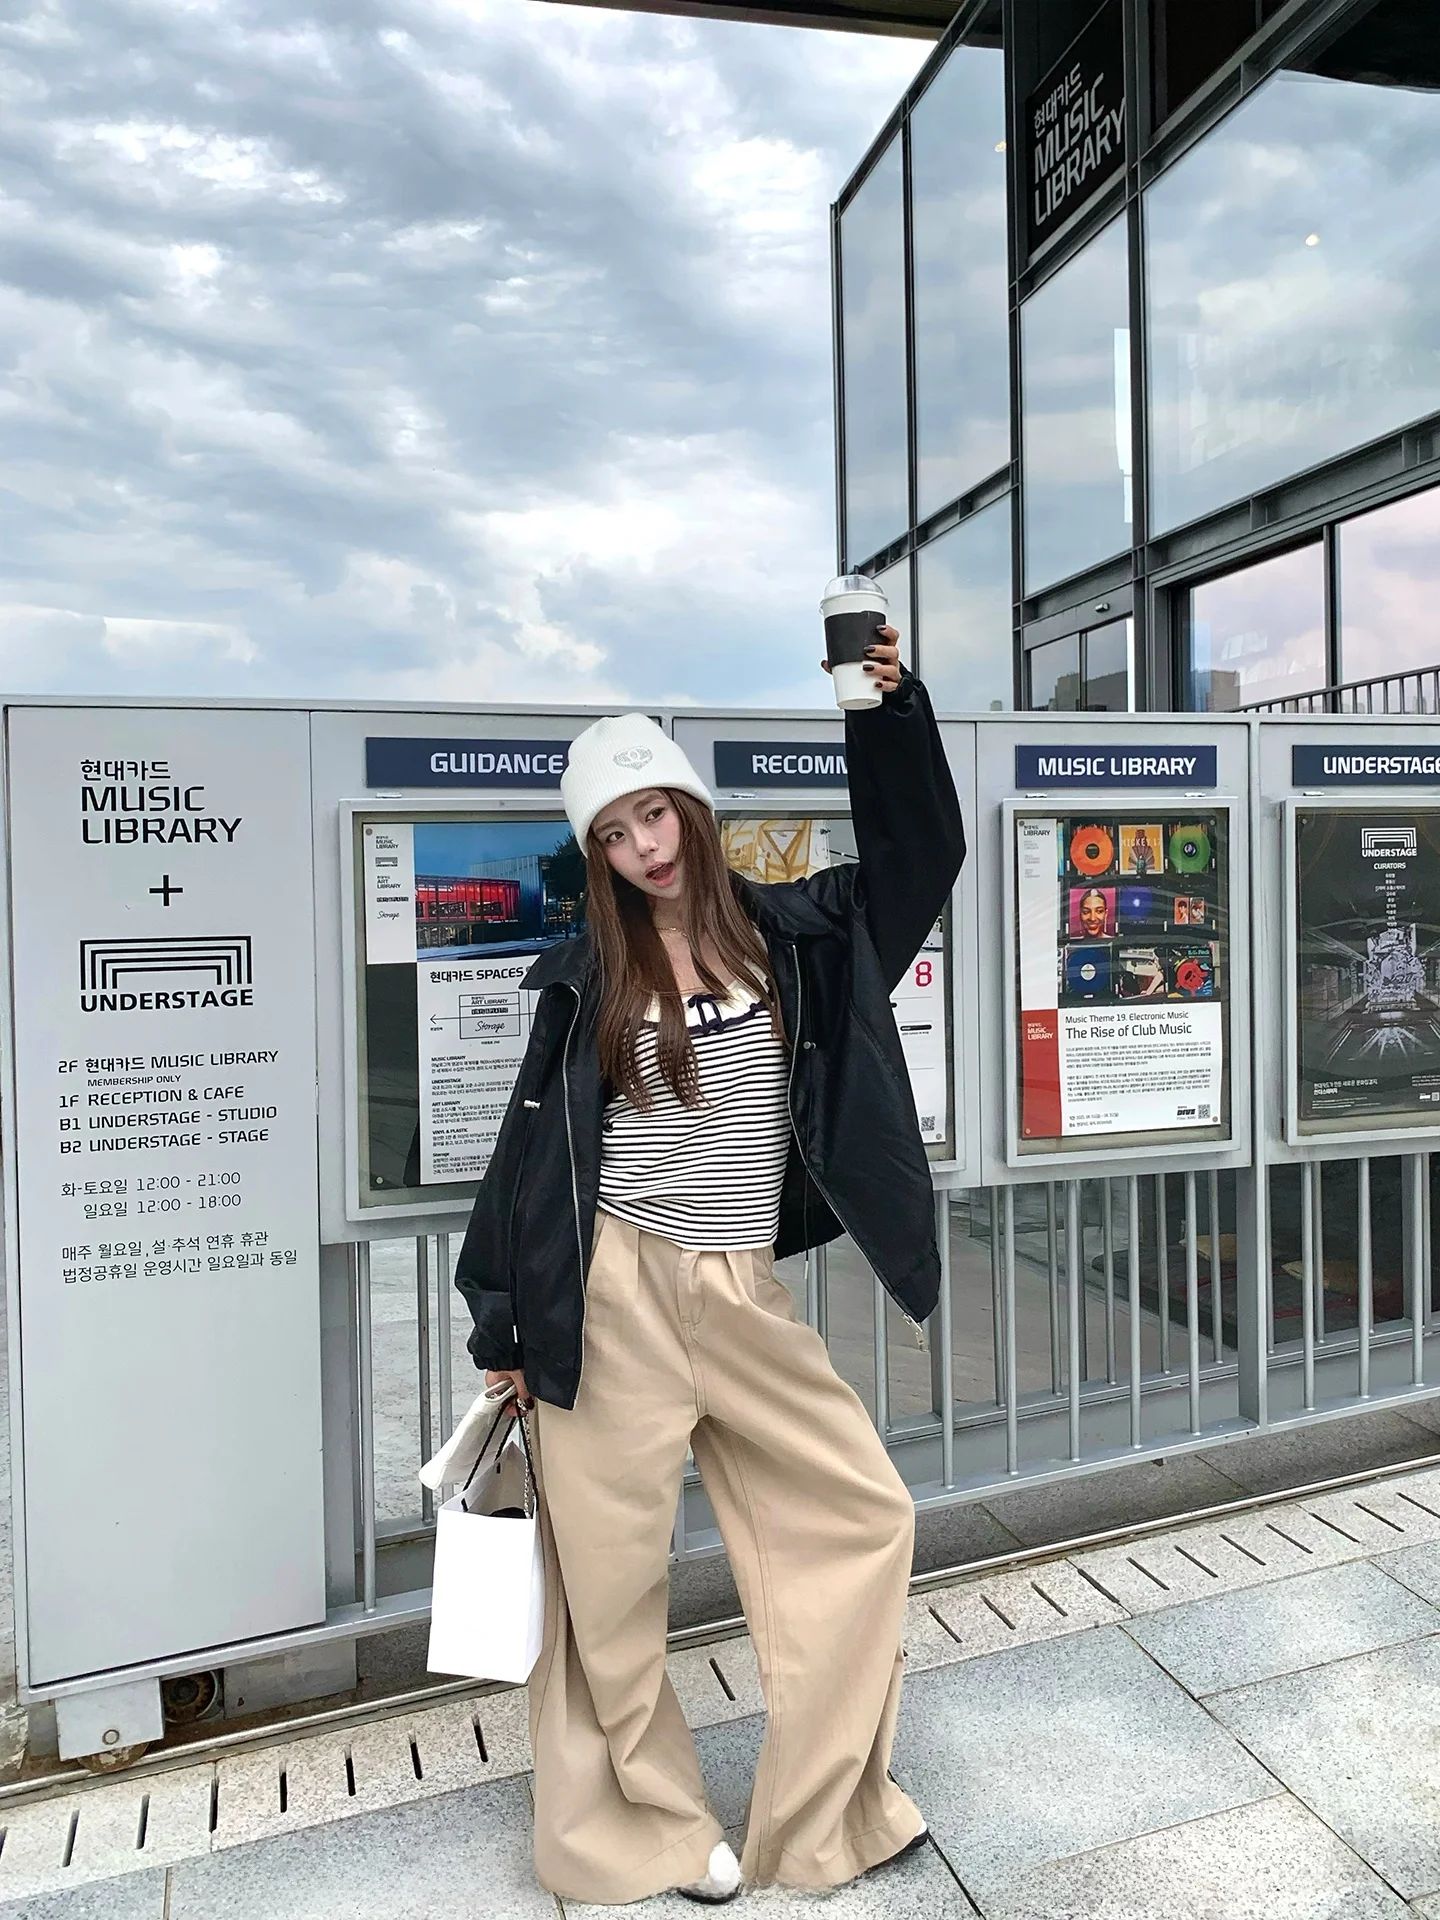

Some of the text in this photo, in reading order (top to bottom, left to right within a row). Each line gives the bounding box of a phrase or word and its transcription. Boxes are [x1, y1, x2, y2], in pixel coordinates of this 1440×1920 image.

[1034, 62, 1082, 138] 현대카드
[1034, 72, 1105, 184] MUSIC
[1034, 96, 1126, 226] LIBRARY
[80, 759, 171, 781] 현대카드
[430, 752, 564, 774] GUIDANCE
[1038, 757, 1196, 776] MUSIC LIBRARY
[81, 786, 205, 811] MUSIC
[82, 817, 242, 844] LIBRARY
[1362, 848, 1417, 857] UNDERSTAGE
[430, 971, 473, 983] 현대카드
[476, 967, 523, 980] SPACES
[80, 989, 254, 1012] UNDERSTAGE
[475, 1021, 505, 1033] Storage
[1089, 1014, 1114, 1022] Theme
[1129, 1012, 1165, 1020] Electronic
[1167, 1011, 1188, 1019] Music
[1066, 1022, 1192, 1039] The Rise of Club Music
[58, 1051, 279, 1073] 2F 현대카드 MUSIC LIBRARY
[87, 1075, 181, 1087] MEMBERSHIP ONLY
[59, 1086, 244, 1108] 1F RECEPTION & CAFE
[60, 1118, 81, 1131] B1
[89, 1110, 201, 1129] UNDERSTAGE
[218, 1106, 277, 1122] STUDIO
[60, 1140, 82, 1154] B2
[89, 1133, 201, 1152] UNDERSTAGE
[218, 1128, 269, 1144] STAGE
[61, 1179, 128, 1197] 화-토요일
[137, 1176, 180, 1191] 12:00
[198, 1172, 241, 1187] 21:00
[84, 1202, 128, 1219] 일요일
[137, 1198, 180, 1214] 12:00
[198, 1194, 242, 1209] 18:00
[62, 1245, 92, 1261] 매주
[206, 1234, 235, 1250] 연휴
[240, 1231, 269, 1247] 휴관
[63, 1250, 297, 1284] 법정공휴일 운영시간 일요일과 동일
